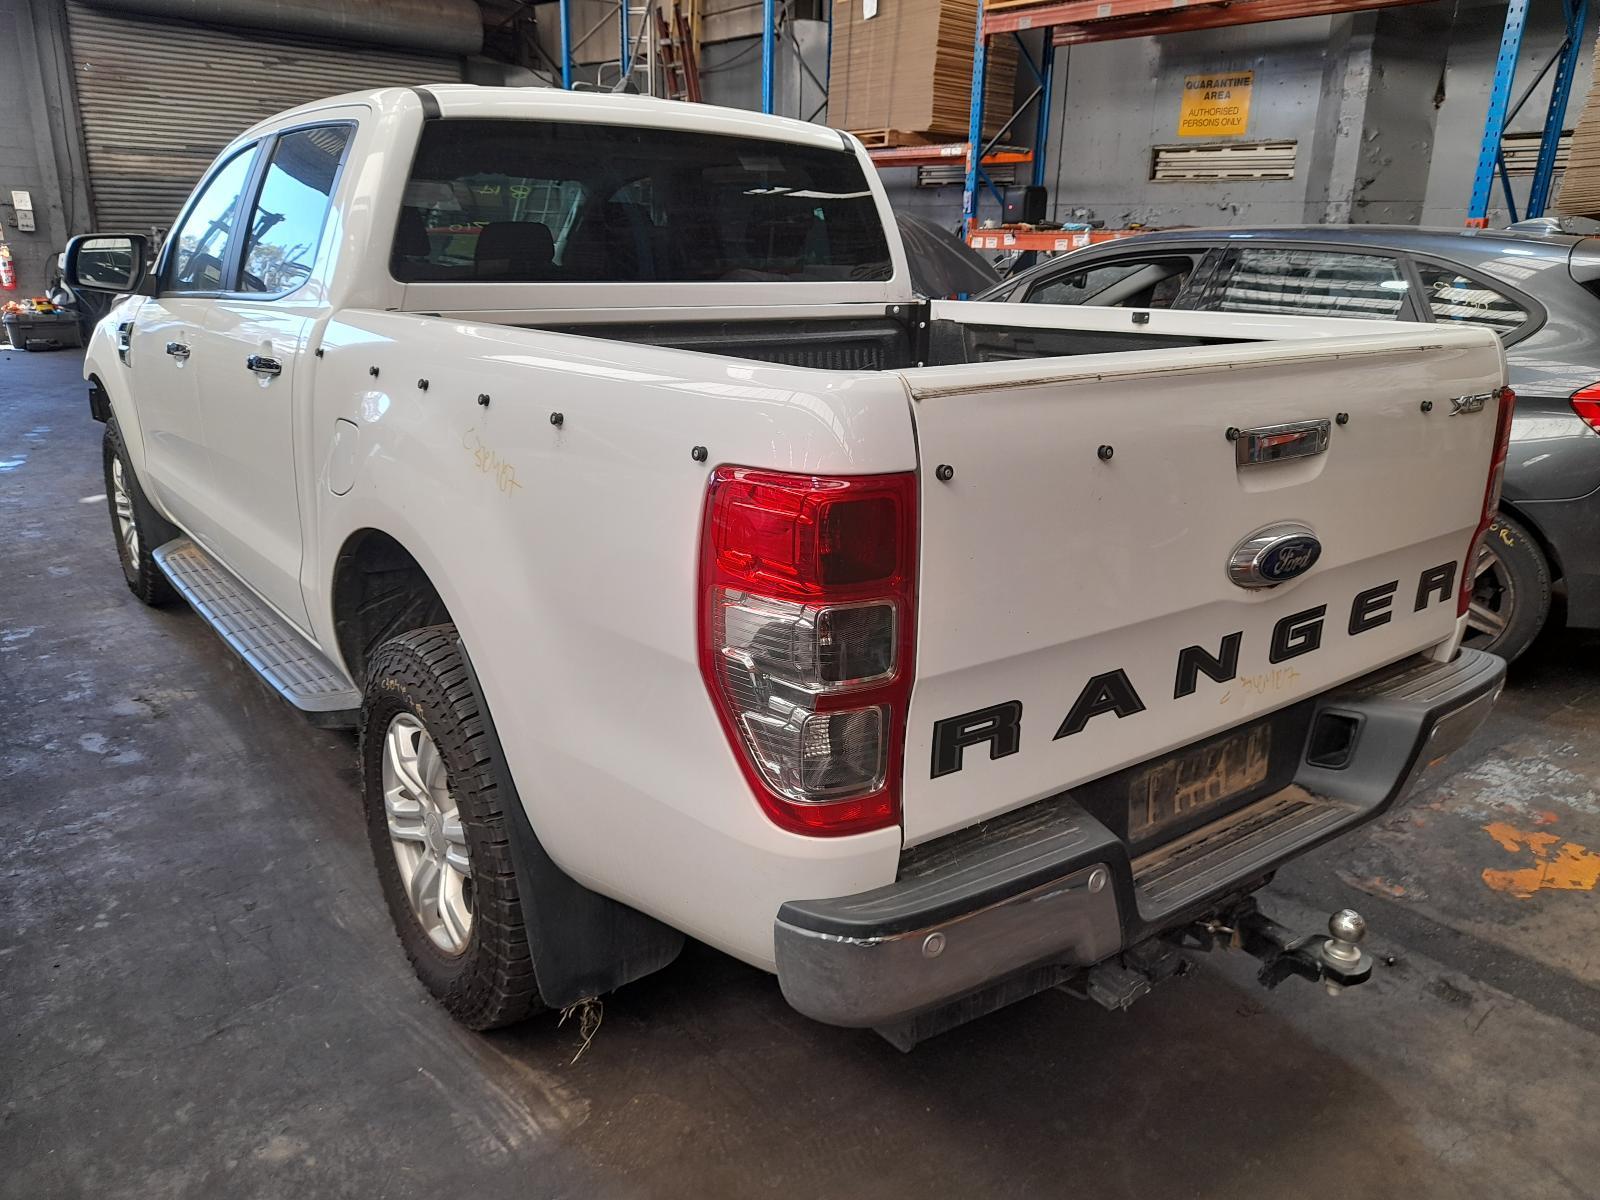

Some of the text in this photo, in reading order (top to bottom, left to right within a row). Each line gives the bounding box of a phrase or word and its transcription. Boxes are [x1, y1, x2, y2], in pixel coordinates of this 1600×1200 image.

[1185, 76, 1251, 90] QUARANTINE
[1203, 91, 1231, 101] AREA
[1188, 106, 1240, 117] AUTHORISED
[1182, 117, 1242, 128] PERSONS ONLY
[1274, 544, 1313, 576] Ford
[930, 560, 1458, 779] RANGER
